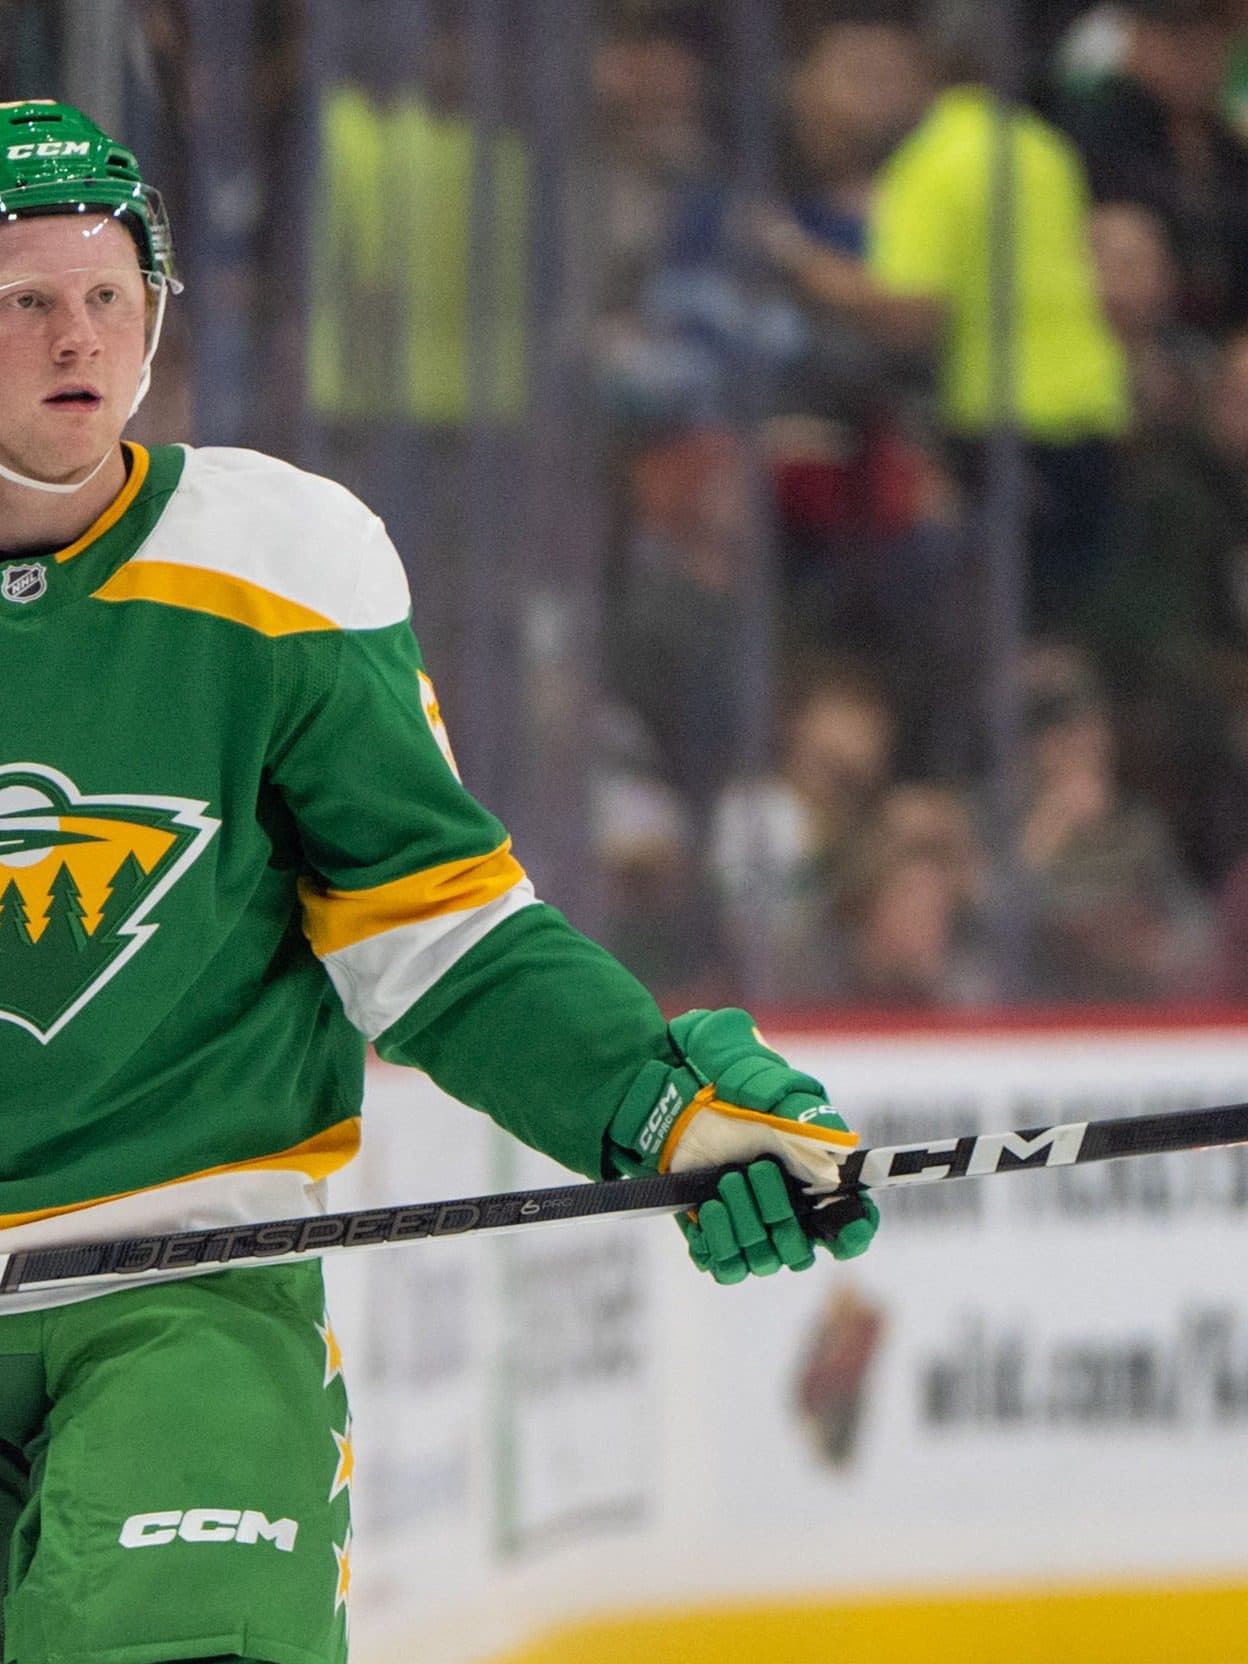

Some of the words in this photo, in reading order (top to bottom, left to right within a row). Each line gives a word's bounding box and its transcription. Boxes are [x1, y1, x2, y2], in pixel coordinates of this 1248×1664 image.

[7, 141, 90, 160] CCM
[639, 1081, 678, 1152] CCM
[858, 1121, 1089, 1188] CM
[115, 1201, 481, 1274] JETSPEED
[118, 1508, 299, 1552] CCM
